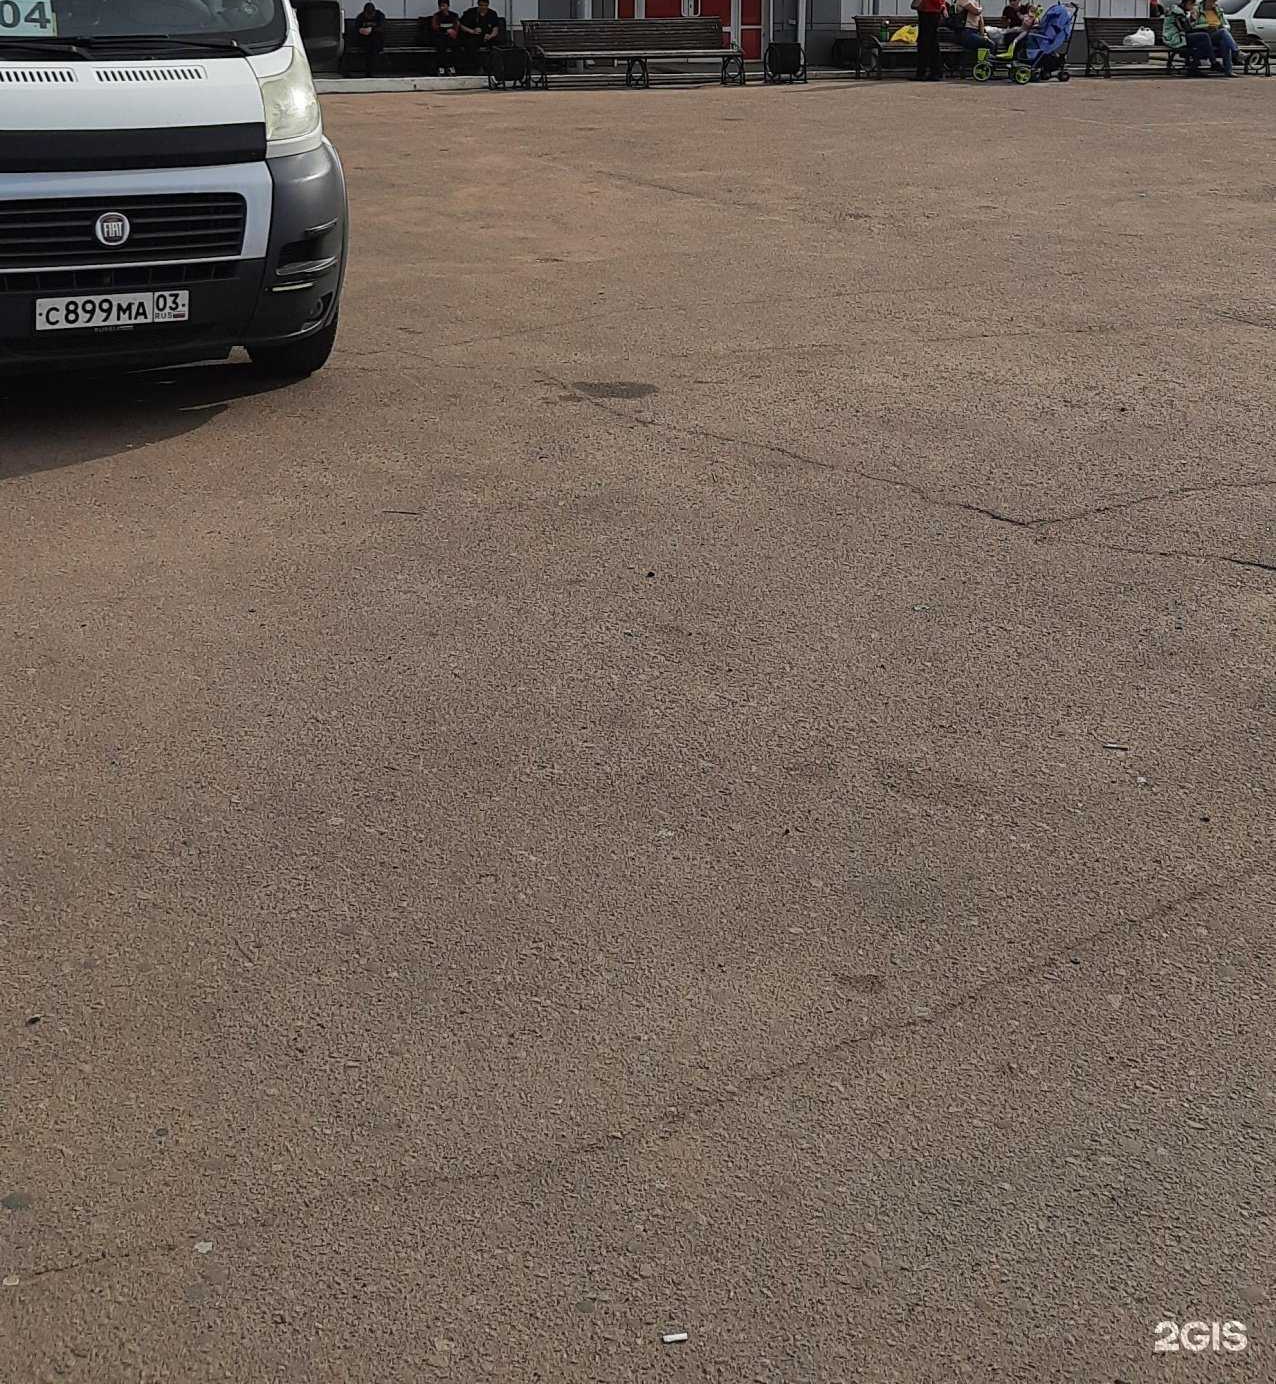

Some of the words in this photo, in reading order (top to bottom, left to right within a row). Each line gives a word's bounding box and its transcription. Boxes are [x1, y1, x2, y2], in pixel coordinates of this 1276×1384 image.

[103, 221, 123, 238] FIAT
[45, 298, 149, 326] С899МА
[155, 293, 180, 312] 03
